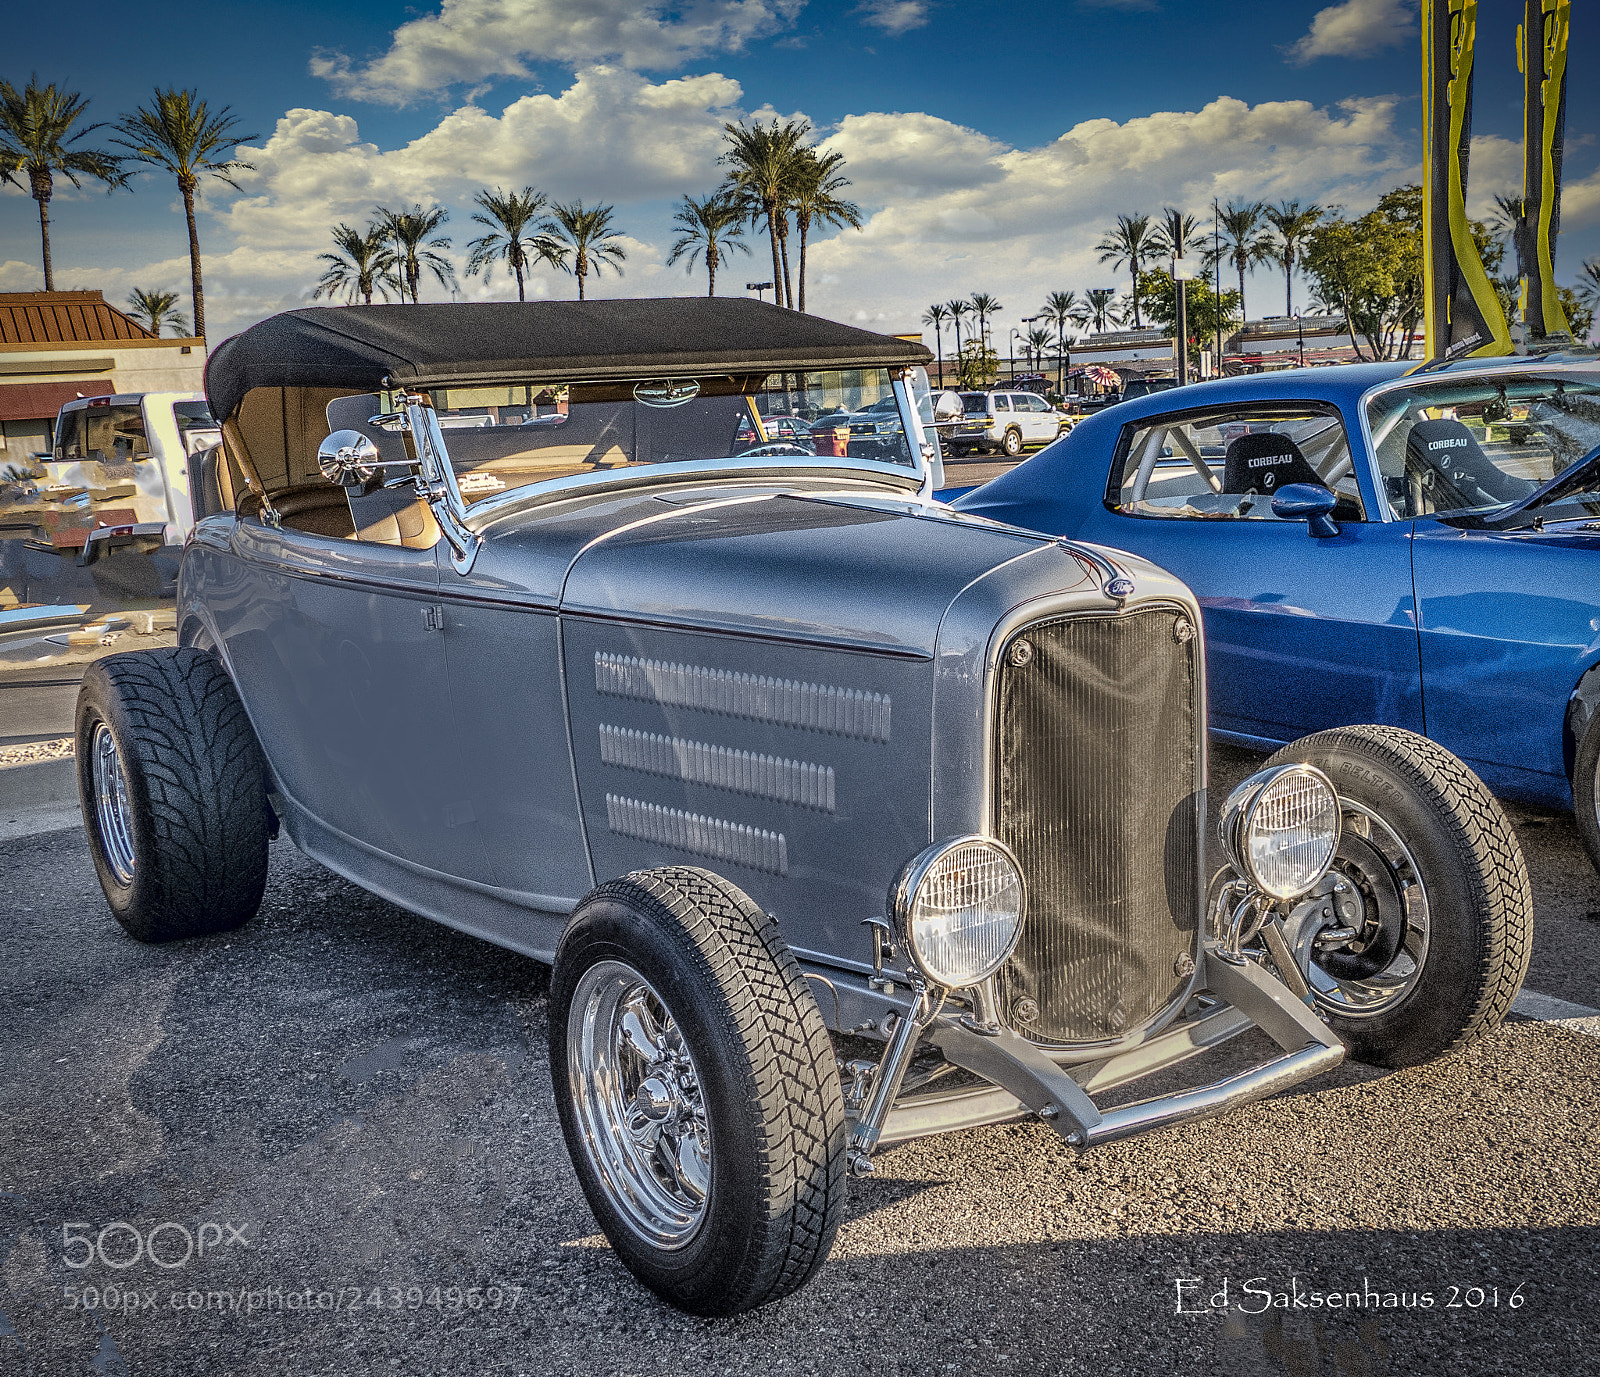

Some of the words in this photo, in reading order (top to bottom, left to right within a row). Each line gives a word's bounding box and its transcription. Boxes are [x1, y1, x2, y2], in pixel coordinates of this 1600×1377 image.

[1427, 438, 1468, 451] CORBEAU
[1248, 454, 1293, 468] CORBEAU
[1340, 761, 1404, 803] BELTED
